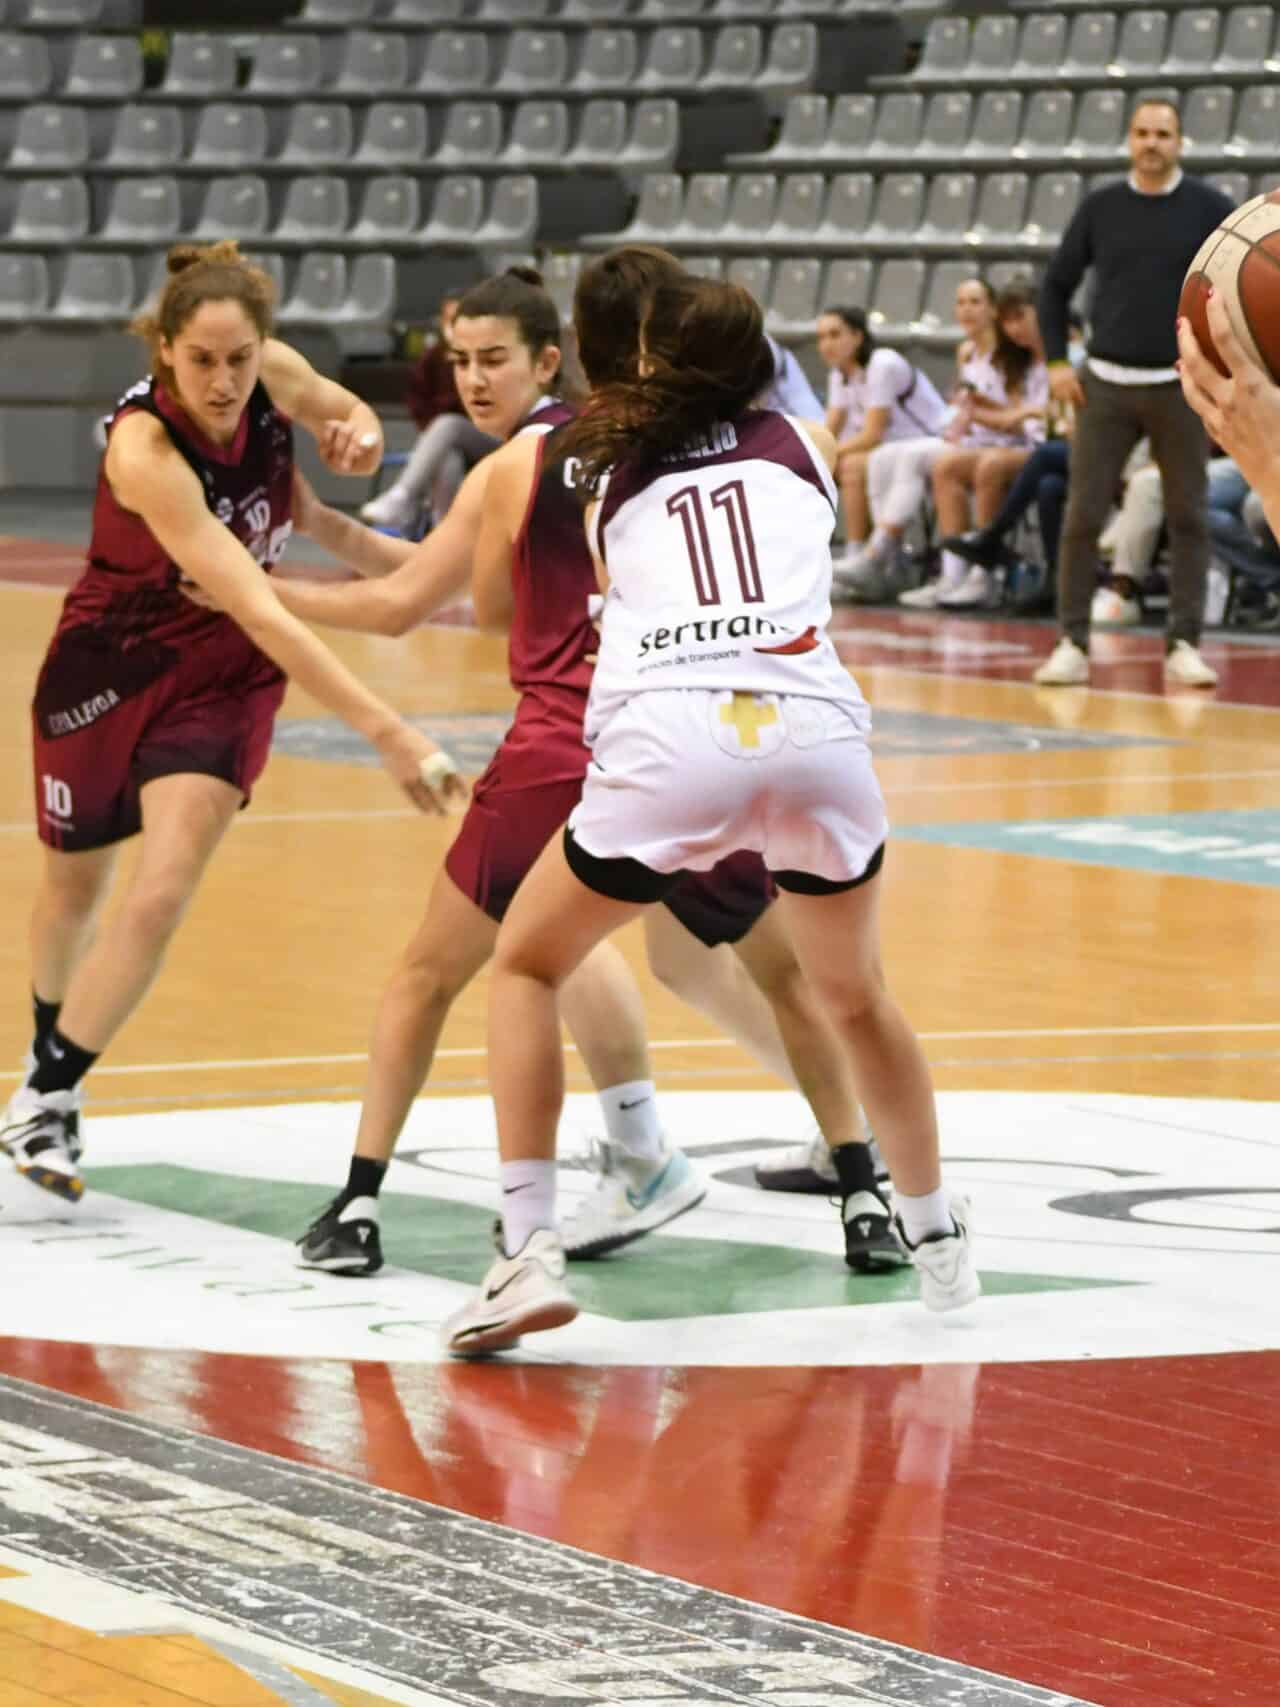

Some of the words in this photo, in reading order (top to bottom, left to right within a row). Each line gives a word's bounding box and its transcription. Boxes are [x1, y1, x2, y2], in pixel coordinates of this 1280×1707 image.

[665, 479, 766, 606] 11
[637, 615, 796, 658] sertran
[42, 774, 73, 818] 10
